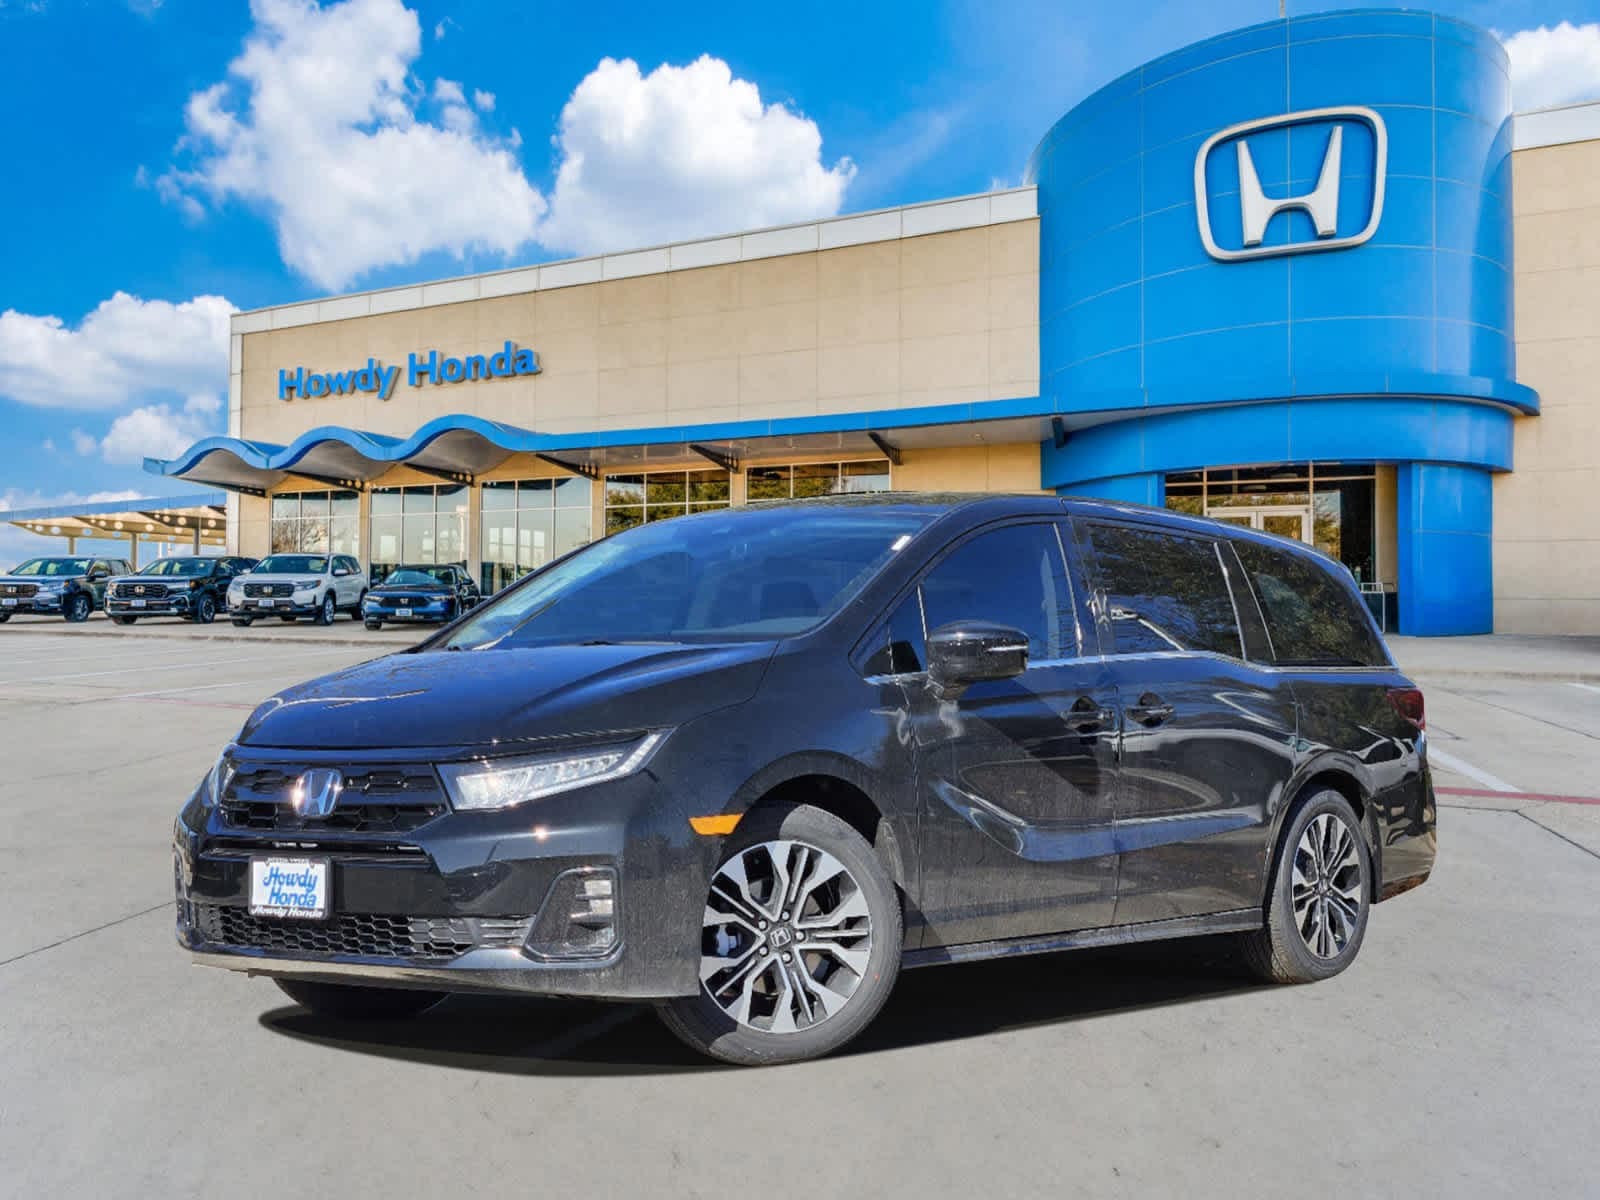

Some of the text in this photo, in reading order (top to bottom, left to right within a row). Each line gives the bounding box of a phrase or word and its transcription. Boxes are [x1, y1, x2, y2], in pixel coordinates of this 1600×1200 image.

[279, 340, 542, 401] Howdy Honda
[263, 866, 318, 893] Howdy
[268, 886, 317, 907] Honda
